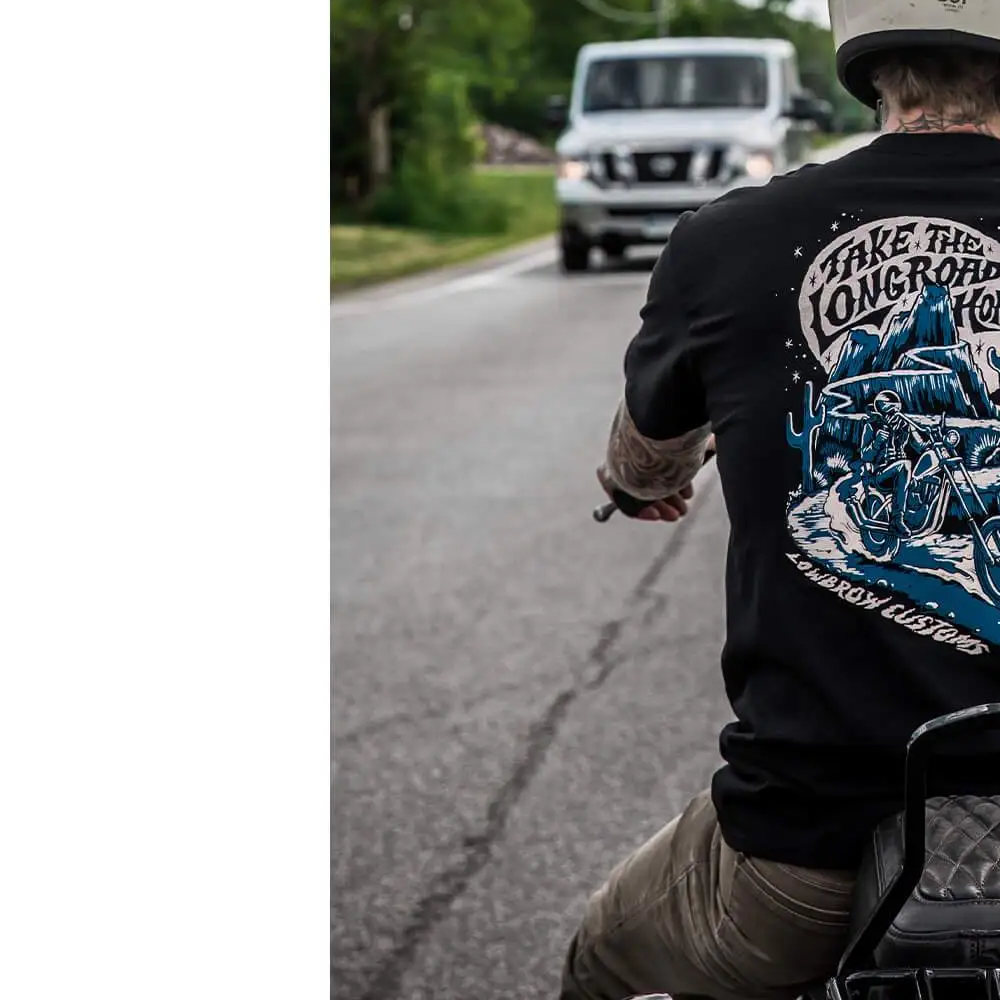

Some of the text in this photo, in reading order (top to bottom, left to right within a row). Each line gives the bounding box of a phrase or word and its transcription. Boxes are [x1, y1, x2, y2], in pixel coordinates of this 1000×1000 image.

[820, 222, 984, 283] TAKE THE
[809, 265, 905, 354] LONG
[785, 552, 990, 655] LOWBROW CUSTOMS
